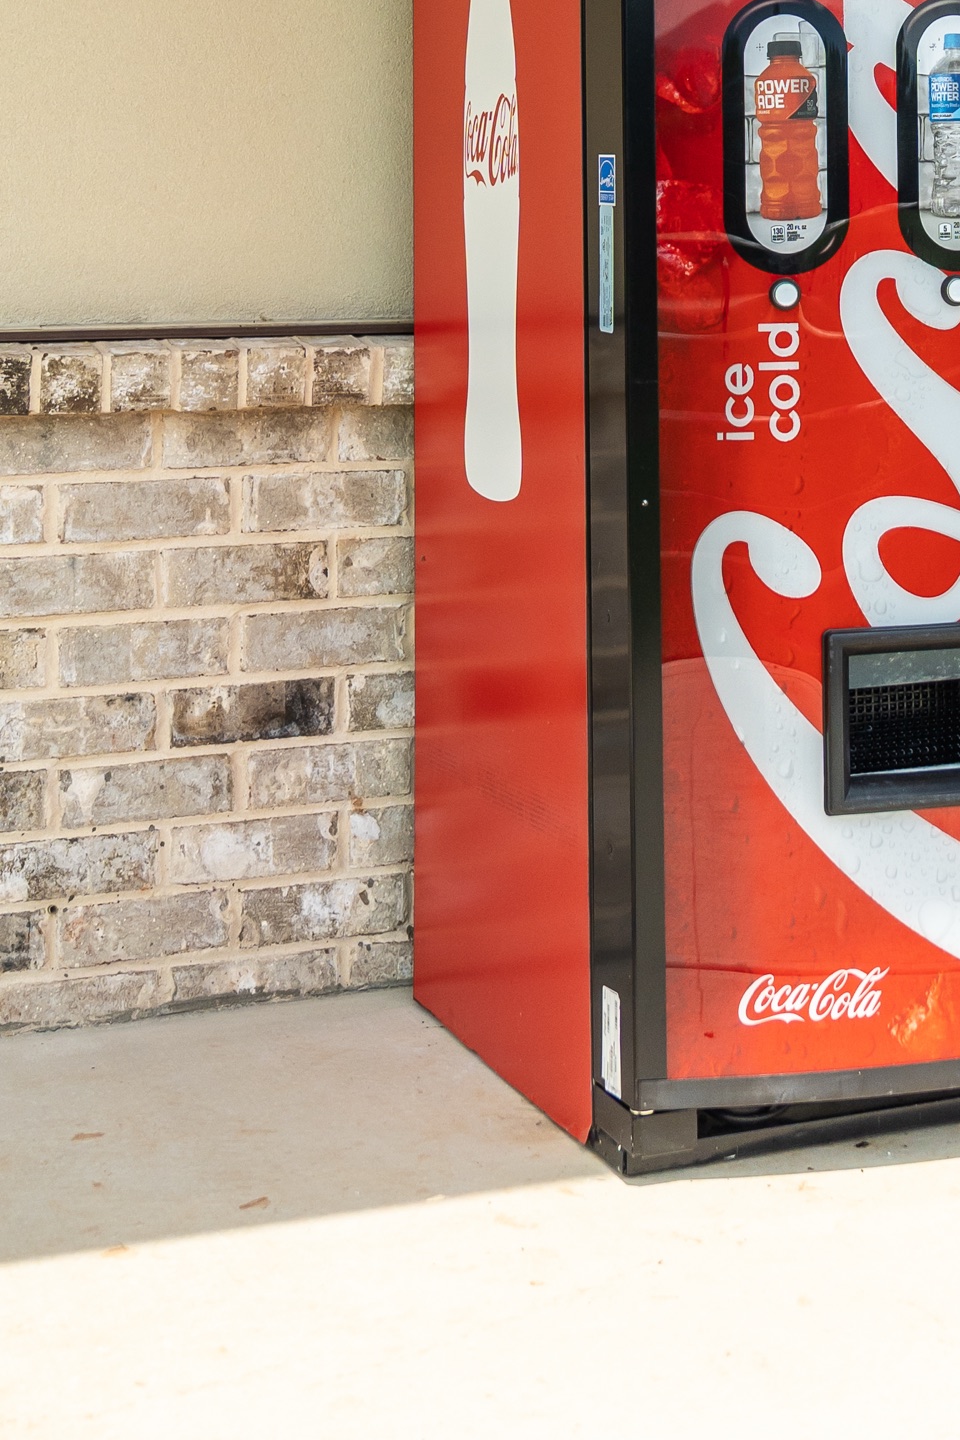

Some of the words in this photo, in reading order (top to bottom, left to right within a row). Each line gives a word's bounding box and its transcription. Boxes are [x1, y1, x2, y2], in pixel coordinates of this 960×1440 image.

[758, 79, 809, 94] POWER
[931, 83, 959, 91] POWER
[758, 94, 785, 109] ADE
[932, 92, 959, 101] WATER
[757, 322, 801, 443] cold
[716, 363, 755, 441] ice
[738, 966, 890, 1026] Coca-Cola
